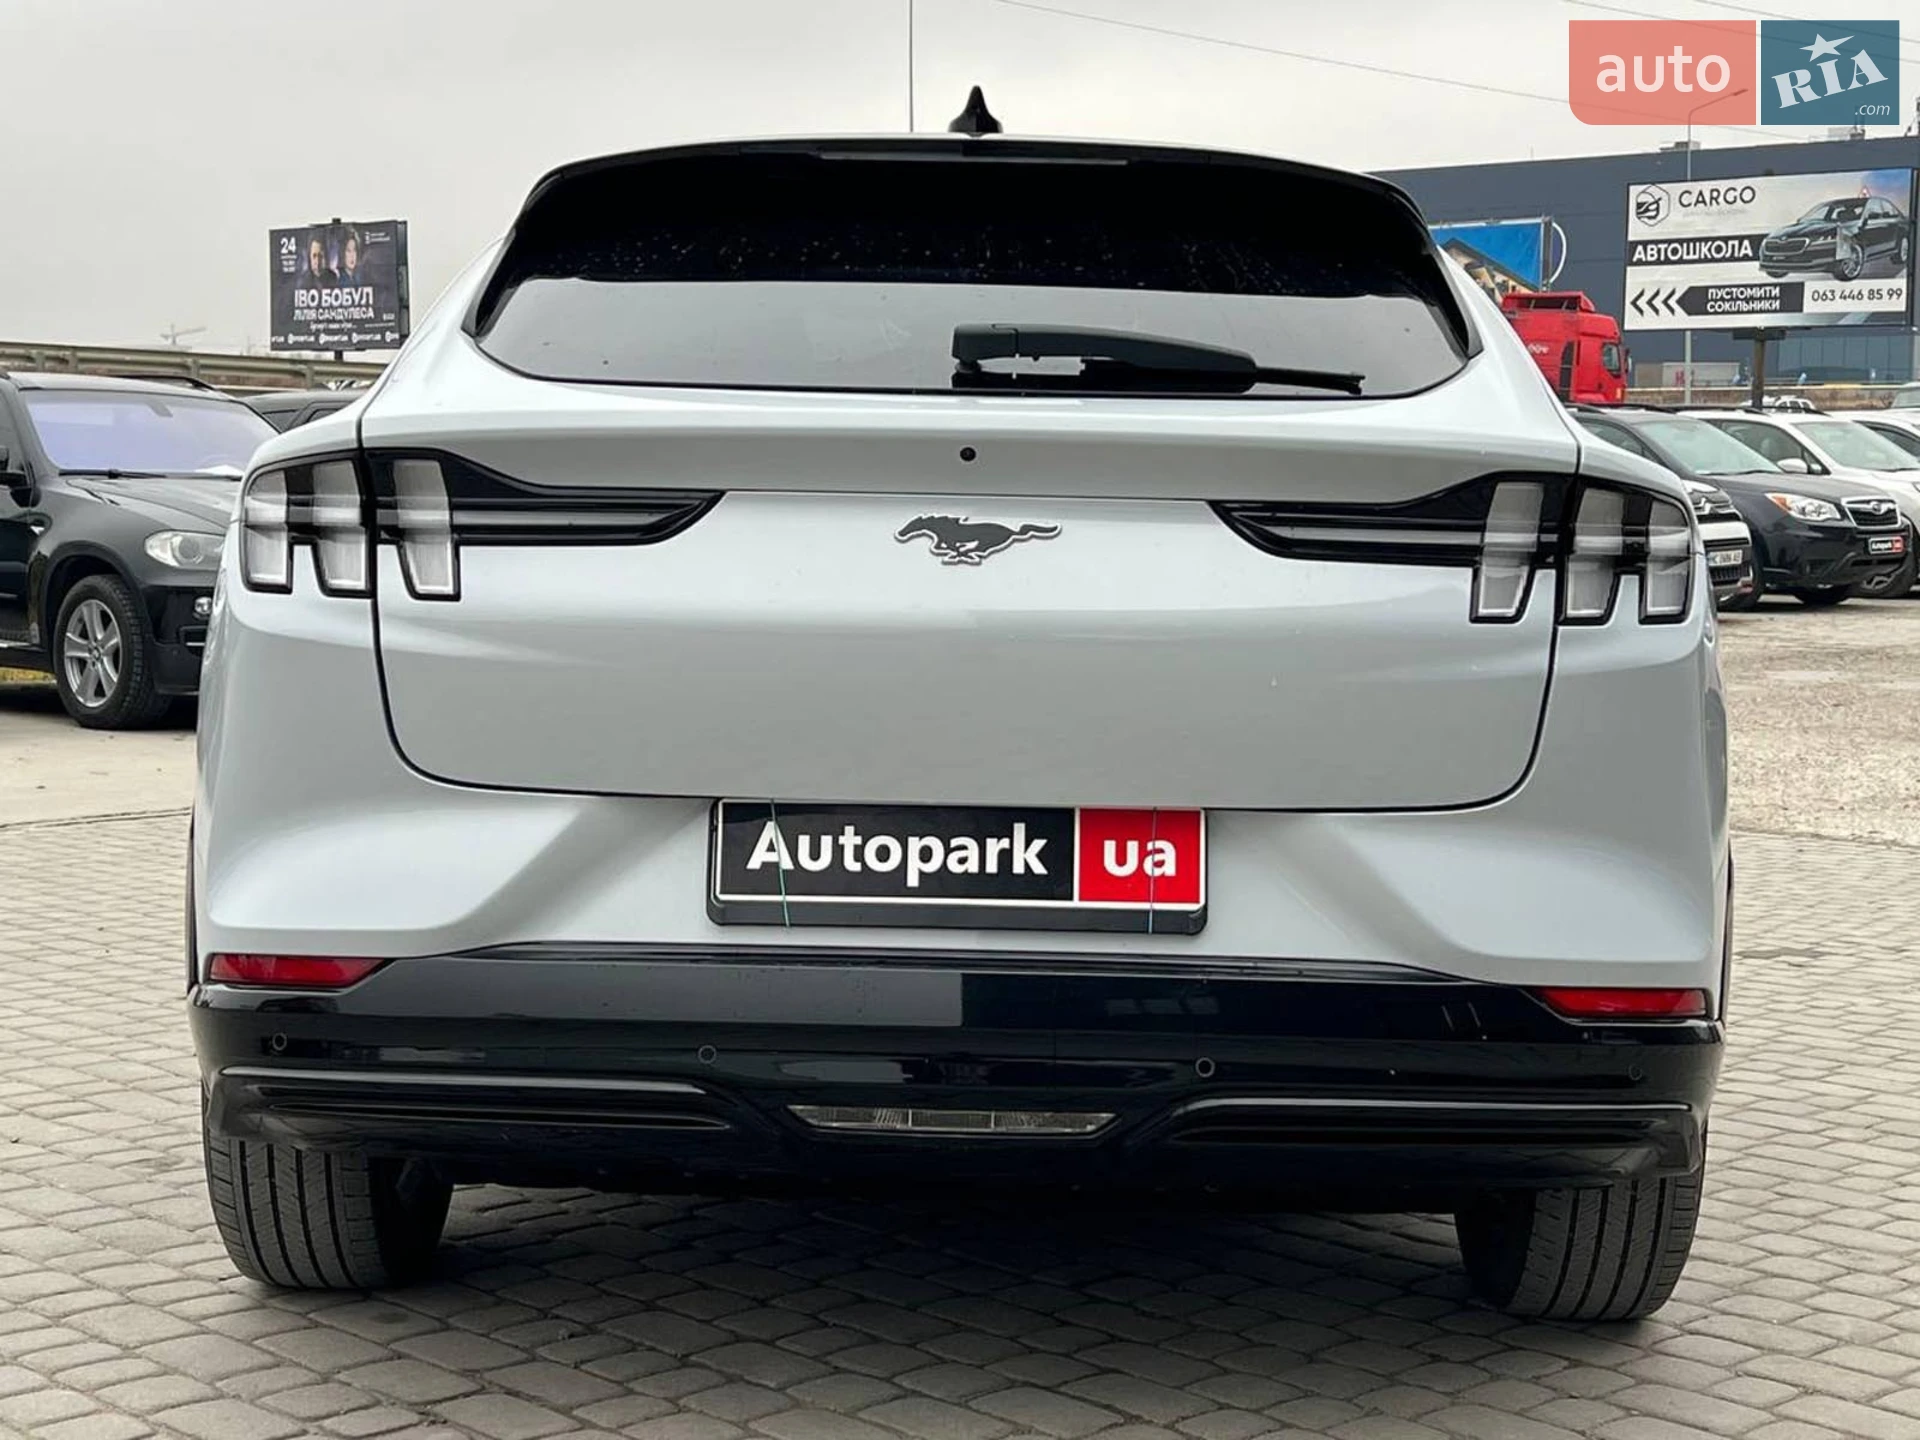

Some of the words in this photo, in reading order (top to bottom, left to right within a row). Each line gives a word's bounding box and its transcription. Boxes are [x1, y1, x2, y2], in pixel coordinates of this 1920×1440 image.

[1678, 185, 1756, 208] CARGO
[280, 236, 297, 254] 24
[1632, 239, 1754, 263] АВТОШКОЛА
[294, 288, 319, 308] ІВО
[321, 286, 374, 308] БОБУЛ
[1708, 286, 1780, 300] ПУСТОМИТИ
[1811, 289, 1837, 302] 063
[1838, 288, 1865, 301] 446
[1867, 287, 1884, 301] 85
[1886, 286, 1904, 301] 99
[1706, 299, 1780, 313] СОКІЛЬНИКИ
[746, 820, 1049, 888] Autopark
[1103, 836, 1177, 878] ua
